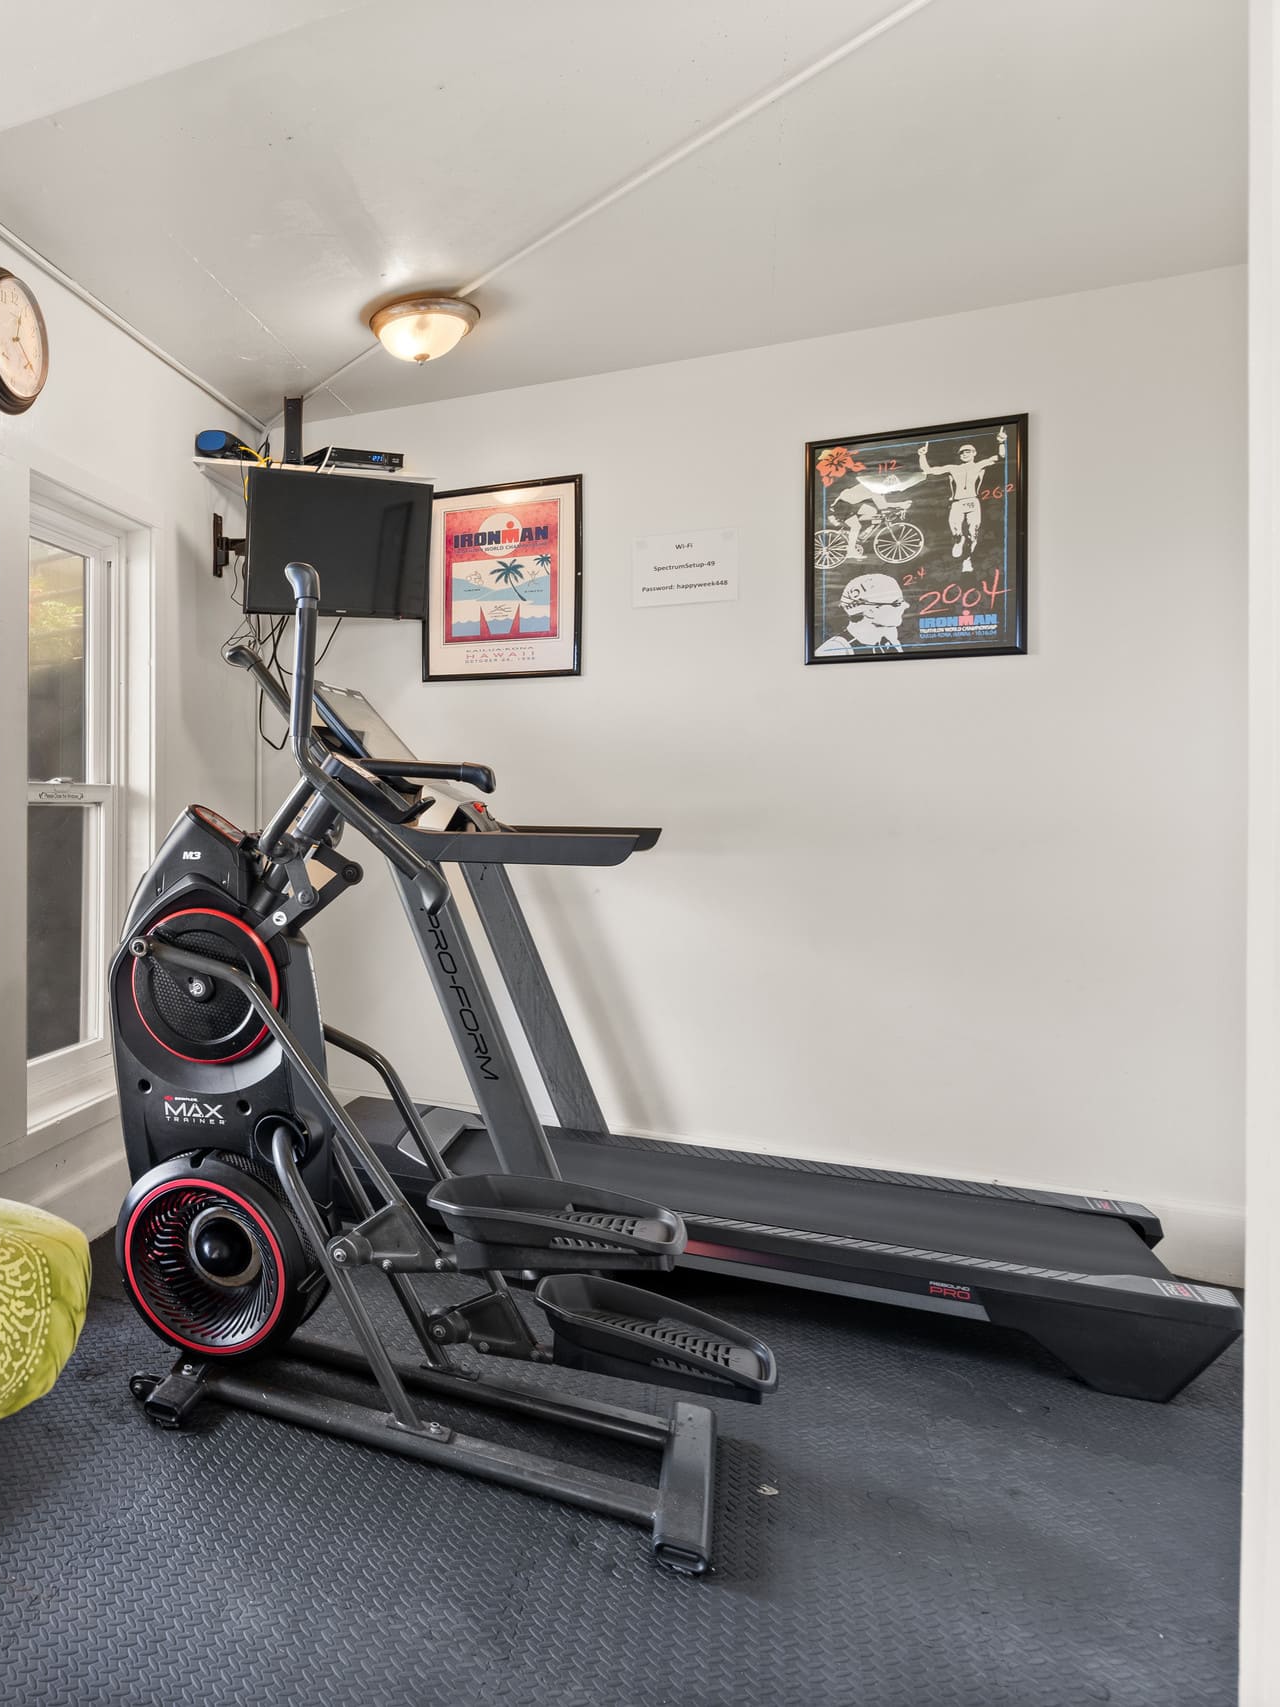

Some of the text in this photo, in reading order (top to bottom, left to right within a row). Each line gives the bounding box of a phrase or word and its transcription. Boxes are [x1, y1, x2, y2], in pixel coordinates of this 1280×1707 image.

[453, 520, 549, 549] IRONMAN
[919, 568, 1012, 615] 2004
[919, 609, 998, 629] IRONMAN
[182, 850, 201, 860] M3
[420, 908, 500, 1081] PRO-FORM
[164, 1101, 224, 1119] MAX
[165, 1116, 225, 1125] TRAINER
[929, 1285, 971, 1300] PRO
